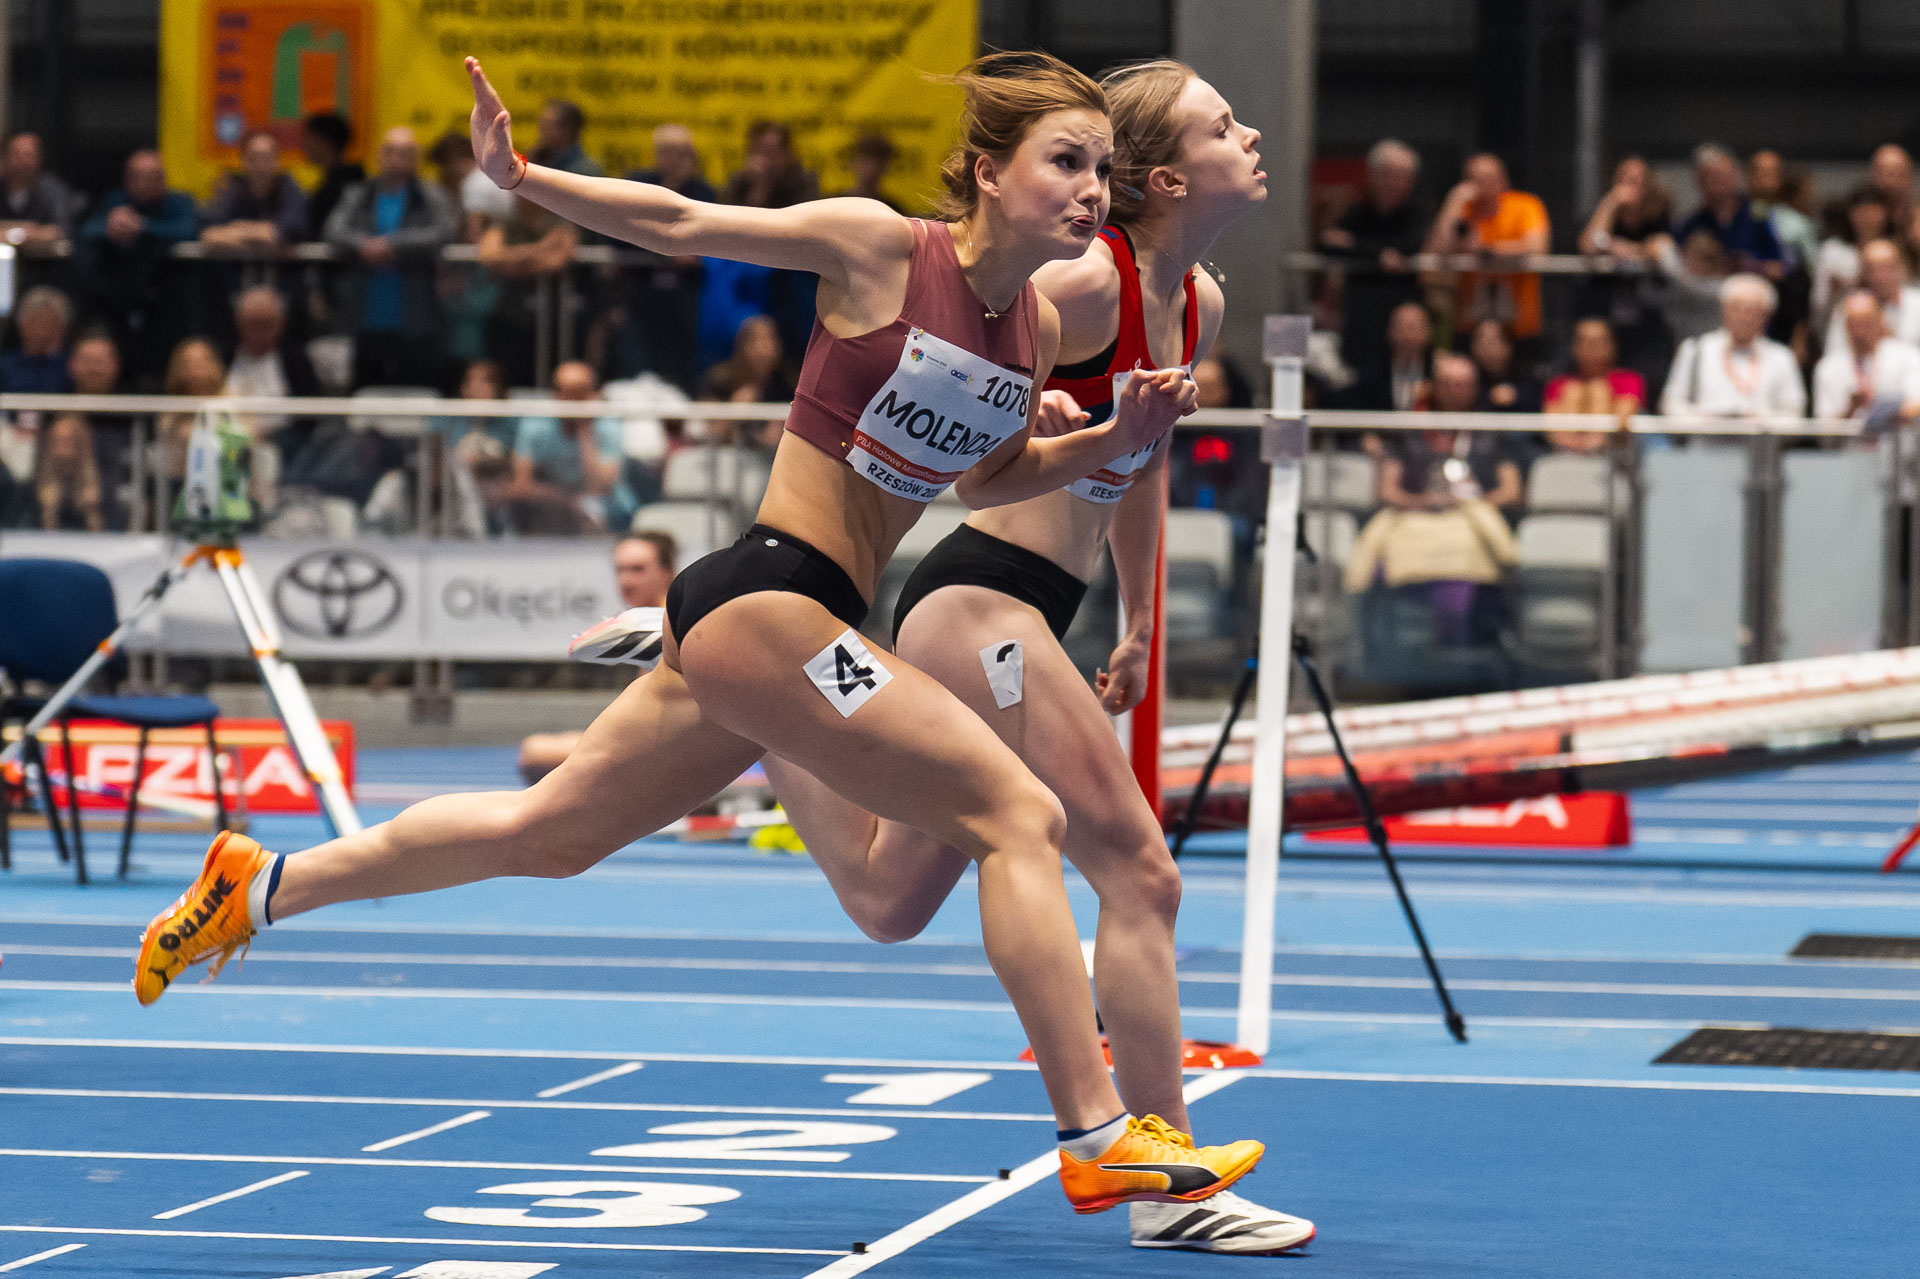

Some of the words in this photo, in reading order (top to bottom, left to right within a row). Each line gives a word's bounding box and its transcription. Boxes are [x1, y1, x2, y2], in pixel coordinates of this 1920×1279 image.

[977, 375, 1029, 418] 1078
[873, 389, 1002, 458] MOLENDA
[856, 435, 871, 449] PZLA
[873, 444, 902, 468] Halowe
[867, 462, 924, 496] RZESZÓW
[441, 576, 600, 631] Okęcie
[834, 643, 877, 697] 4
[158, 870, 240, 951] NITRO
[823, 1072, 993, 1106] 1
[589, 1119, 898, 1163] 2
[423, 1180, 742, 1228] 3
